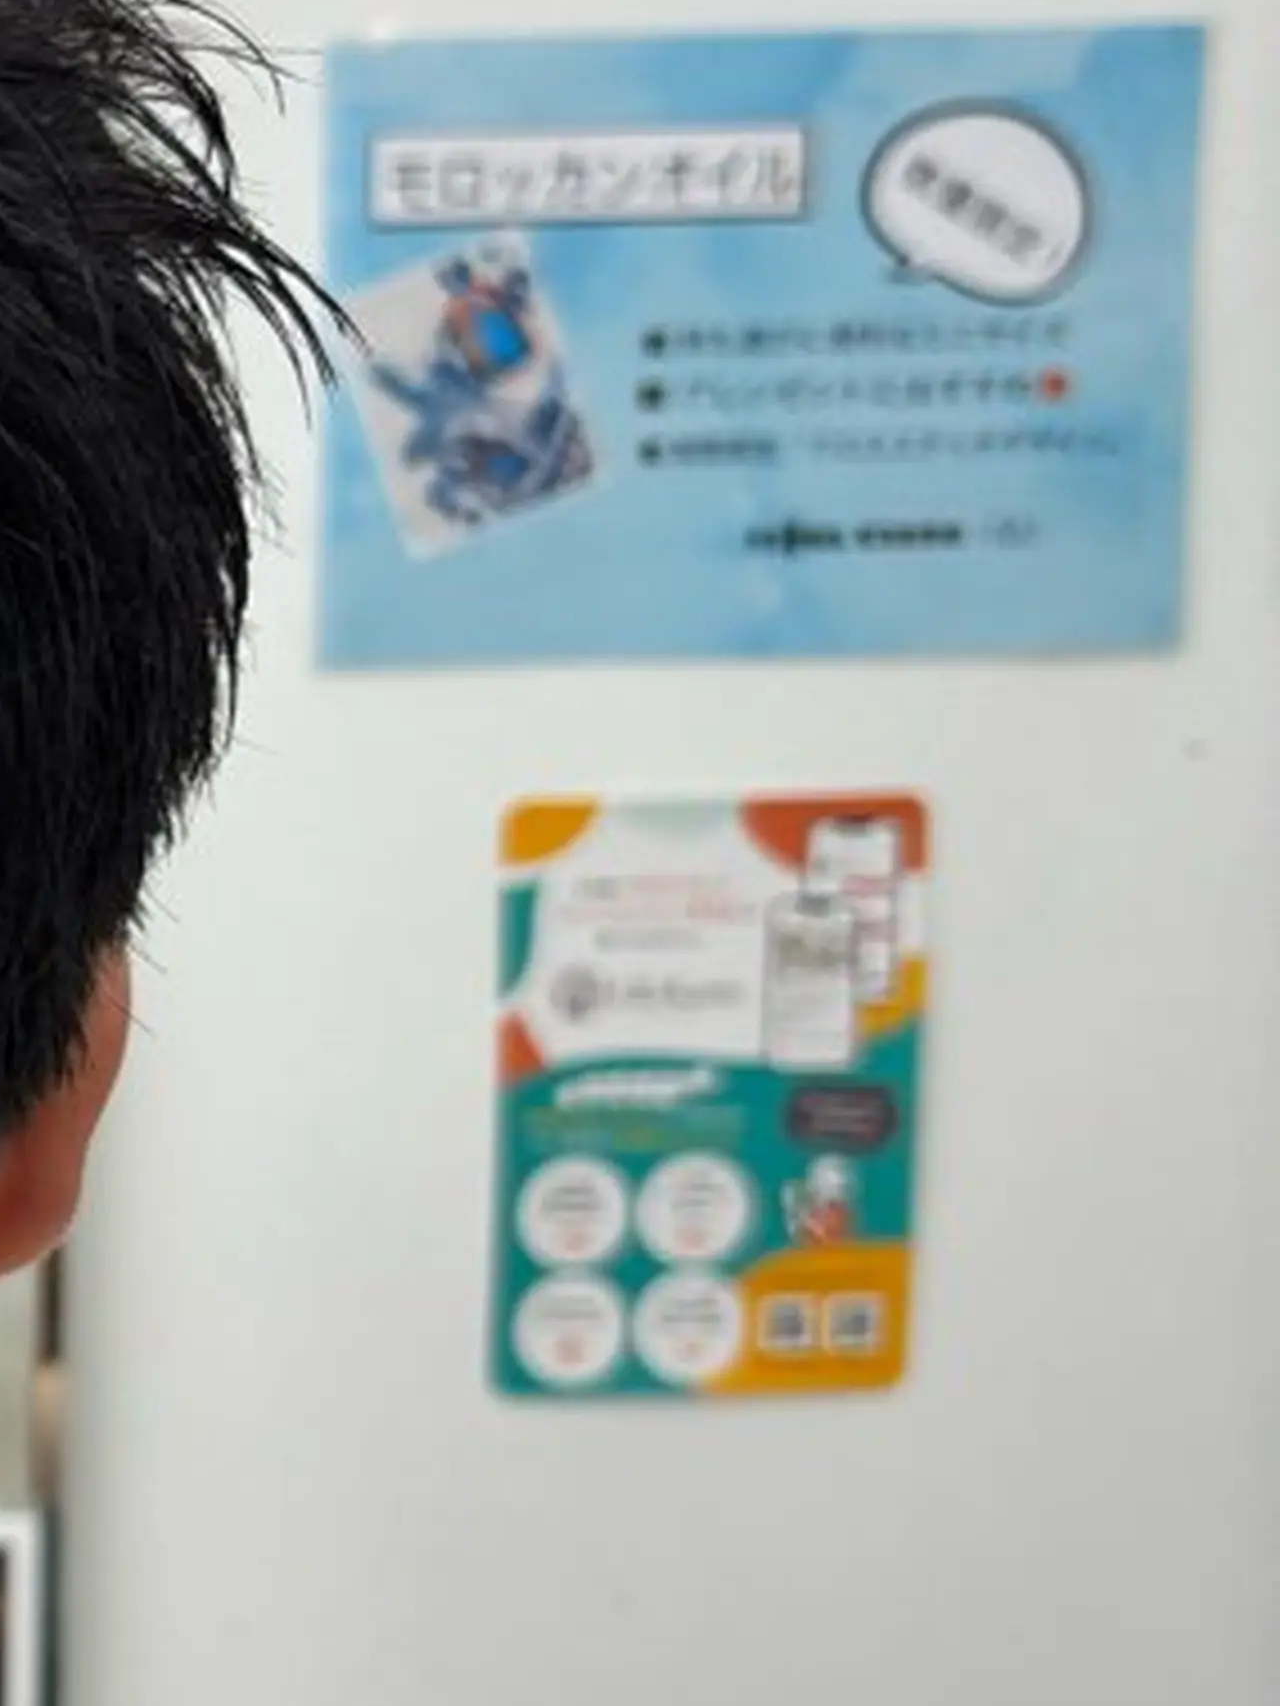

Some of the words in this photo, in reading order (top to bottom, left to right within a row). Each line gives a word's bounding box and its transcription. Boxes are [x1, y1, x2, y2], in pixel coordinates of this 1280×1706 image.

[389, 143, 794, 215] モロッカンオイル
